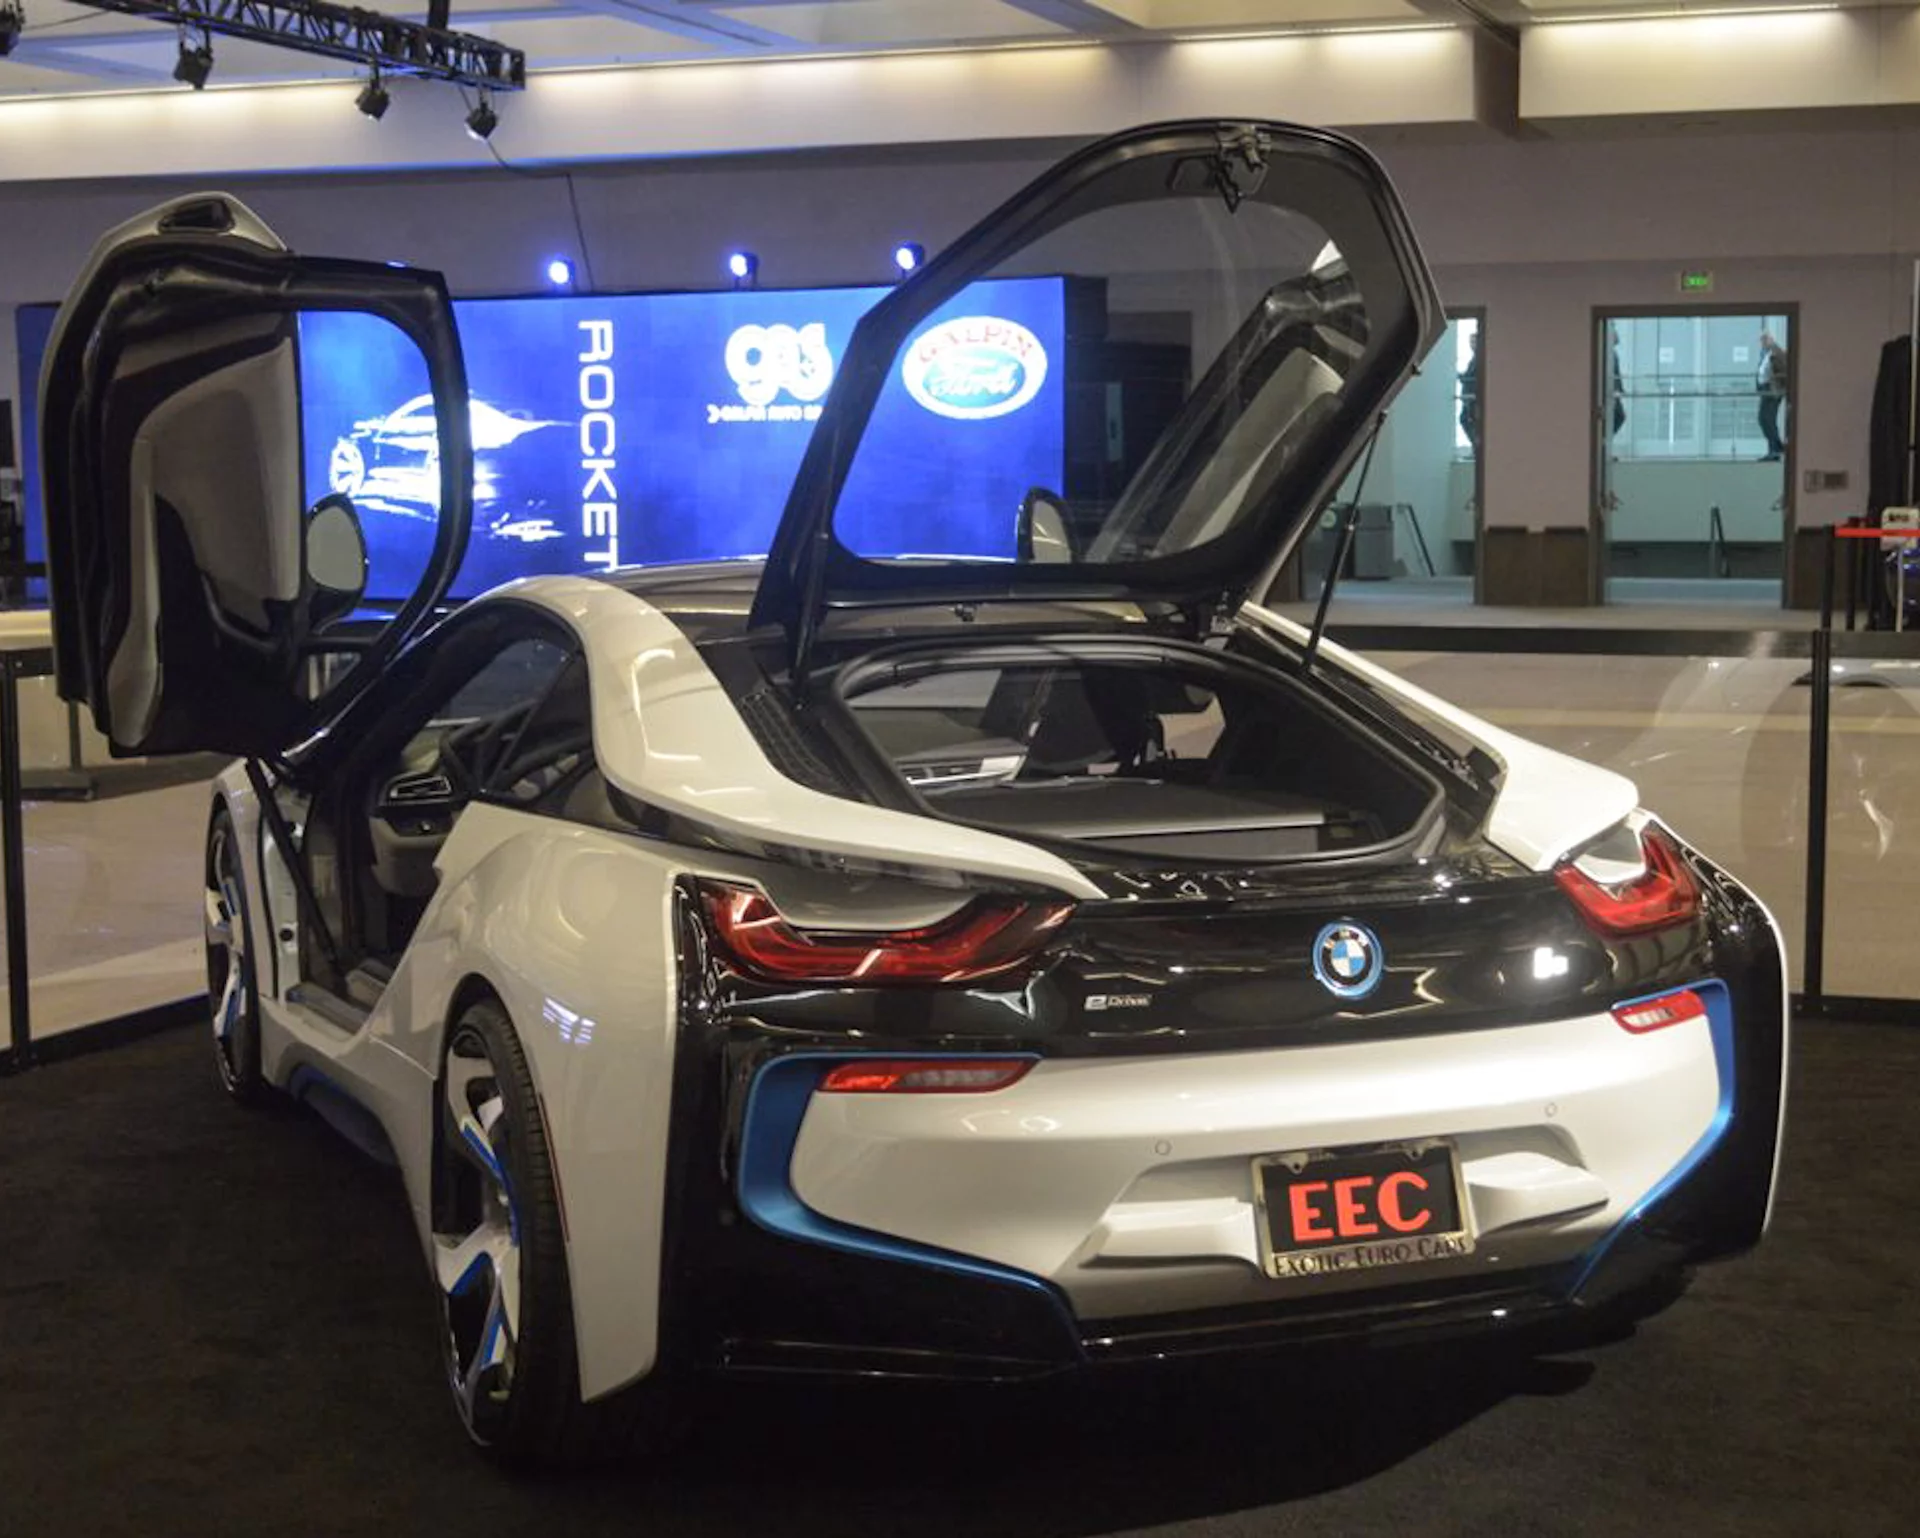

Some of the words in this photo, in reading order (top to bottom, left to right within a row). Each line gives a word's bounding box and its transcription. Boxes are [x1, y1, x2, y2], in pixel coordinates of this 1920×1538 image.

[578, 319, 620, 573] ROCKET
[1288, 1171, 1431, 1243] EEC
[1273, 1251, 1348, 1278] EXOTIC
[1354, 1244, 1409, 1268] EURO
